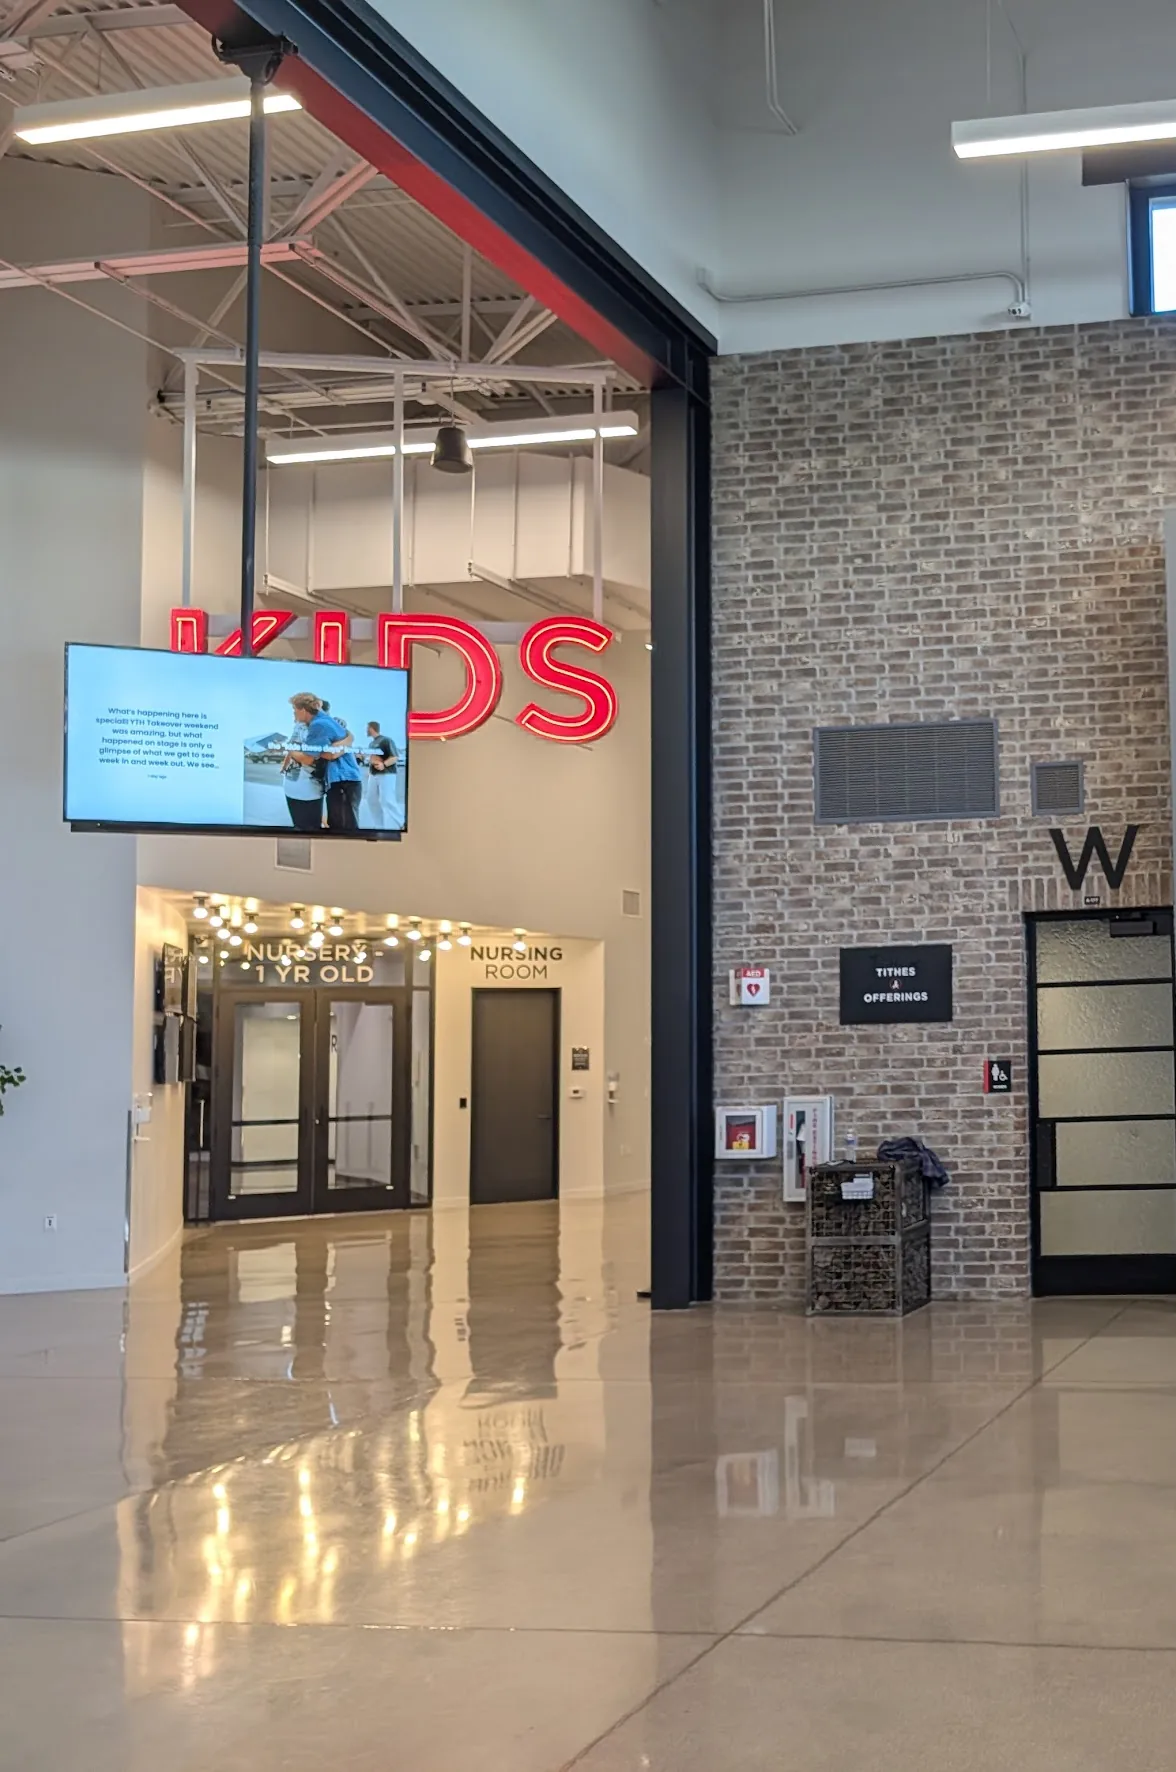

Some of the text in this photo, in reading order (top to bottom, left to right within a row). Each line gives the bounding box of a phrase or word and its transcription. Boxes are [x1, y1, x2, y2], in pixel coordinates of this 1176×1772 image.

[137, 709, 180, 719] happening
[102, 737, 143, 746] happened
[157, 740, 179, 748] stage
[189, 742, 205, 750] only
[99, 747, 131, 756] glimpse
[177, 751, 190, 759] get
[1048, 824, 1140, 890] W
[247, 943, 367, 962] NURSERY
[470, 946, 562, 961] NURSING
[256, 966, 374, 983] 1 YR OLD
[486, 964, 548, 980] ROOM
[875, 966, 916, 978] TITHES
[863, 991, 928, 1003] OFFERINGS
